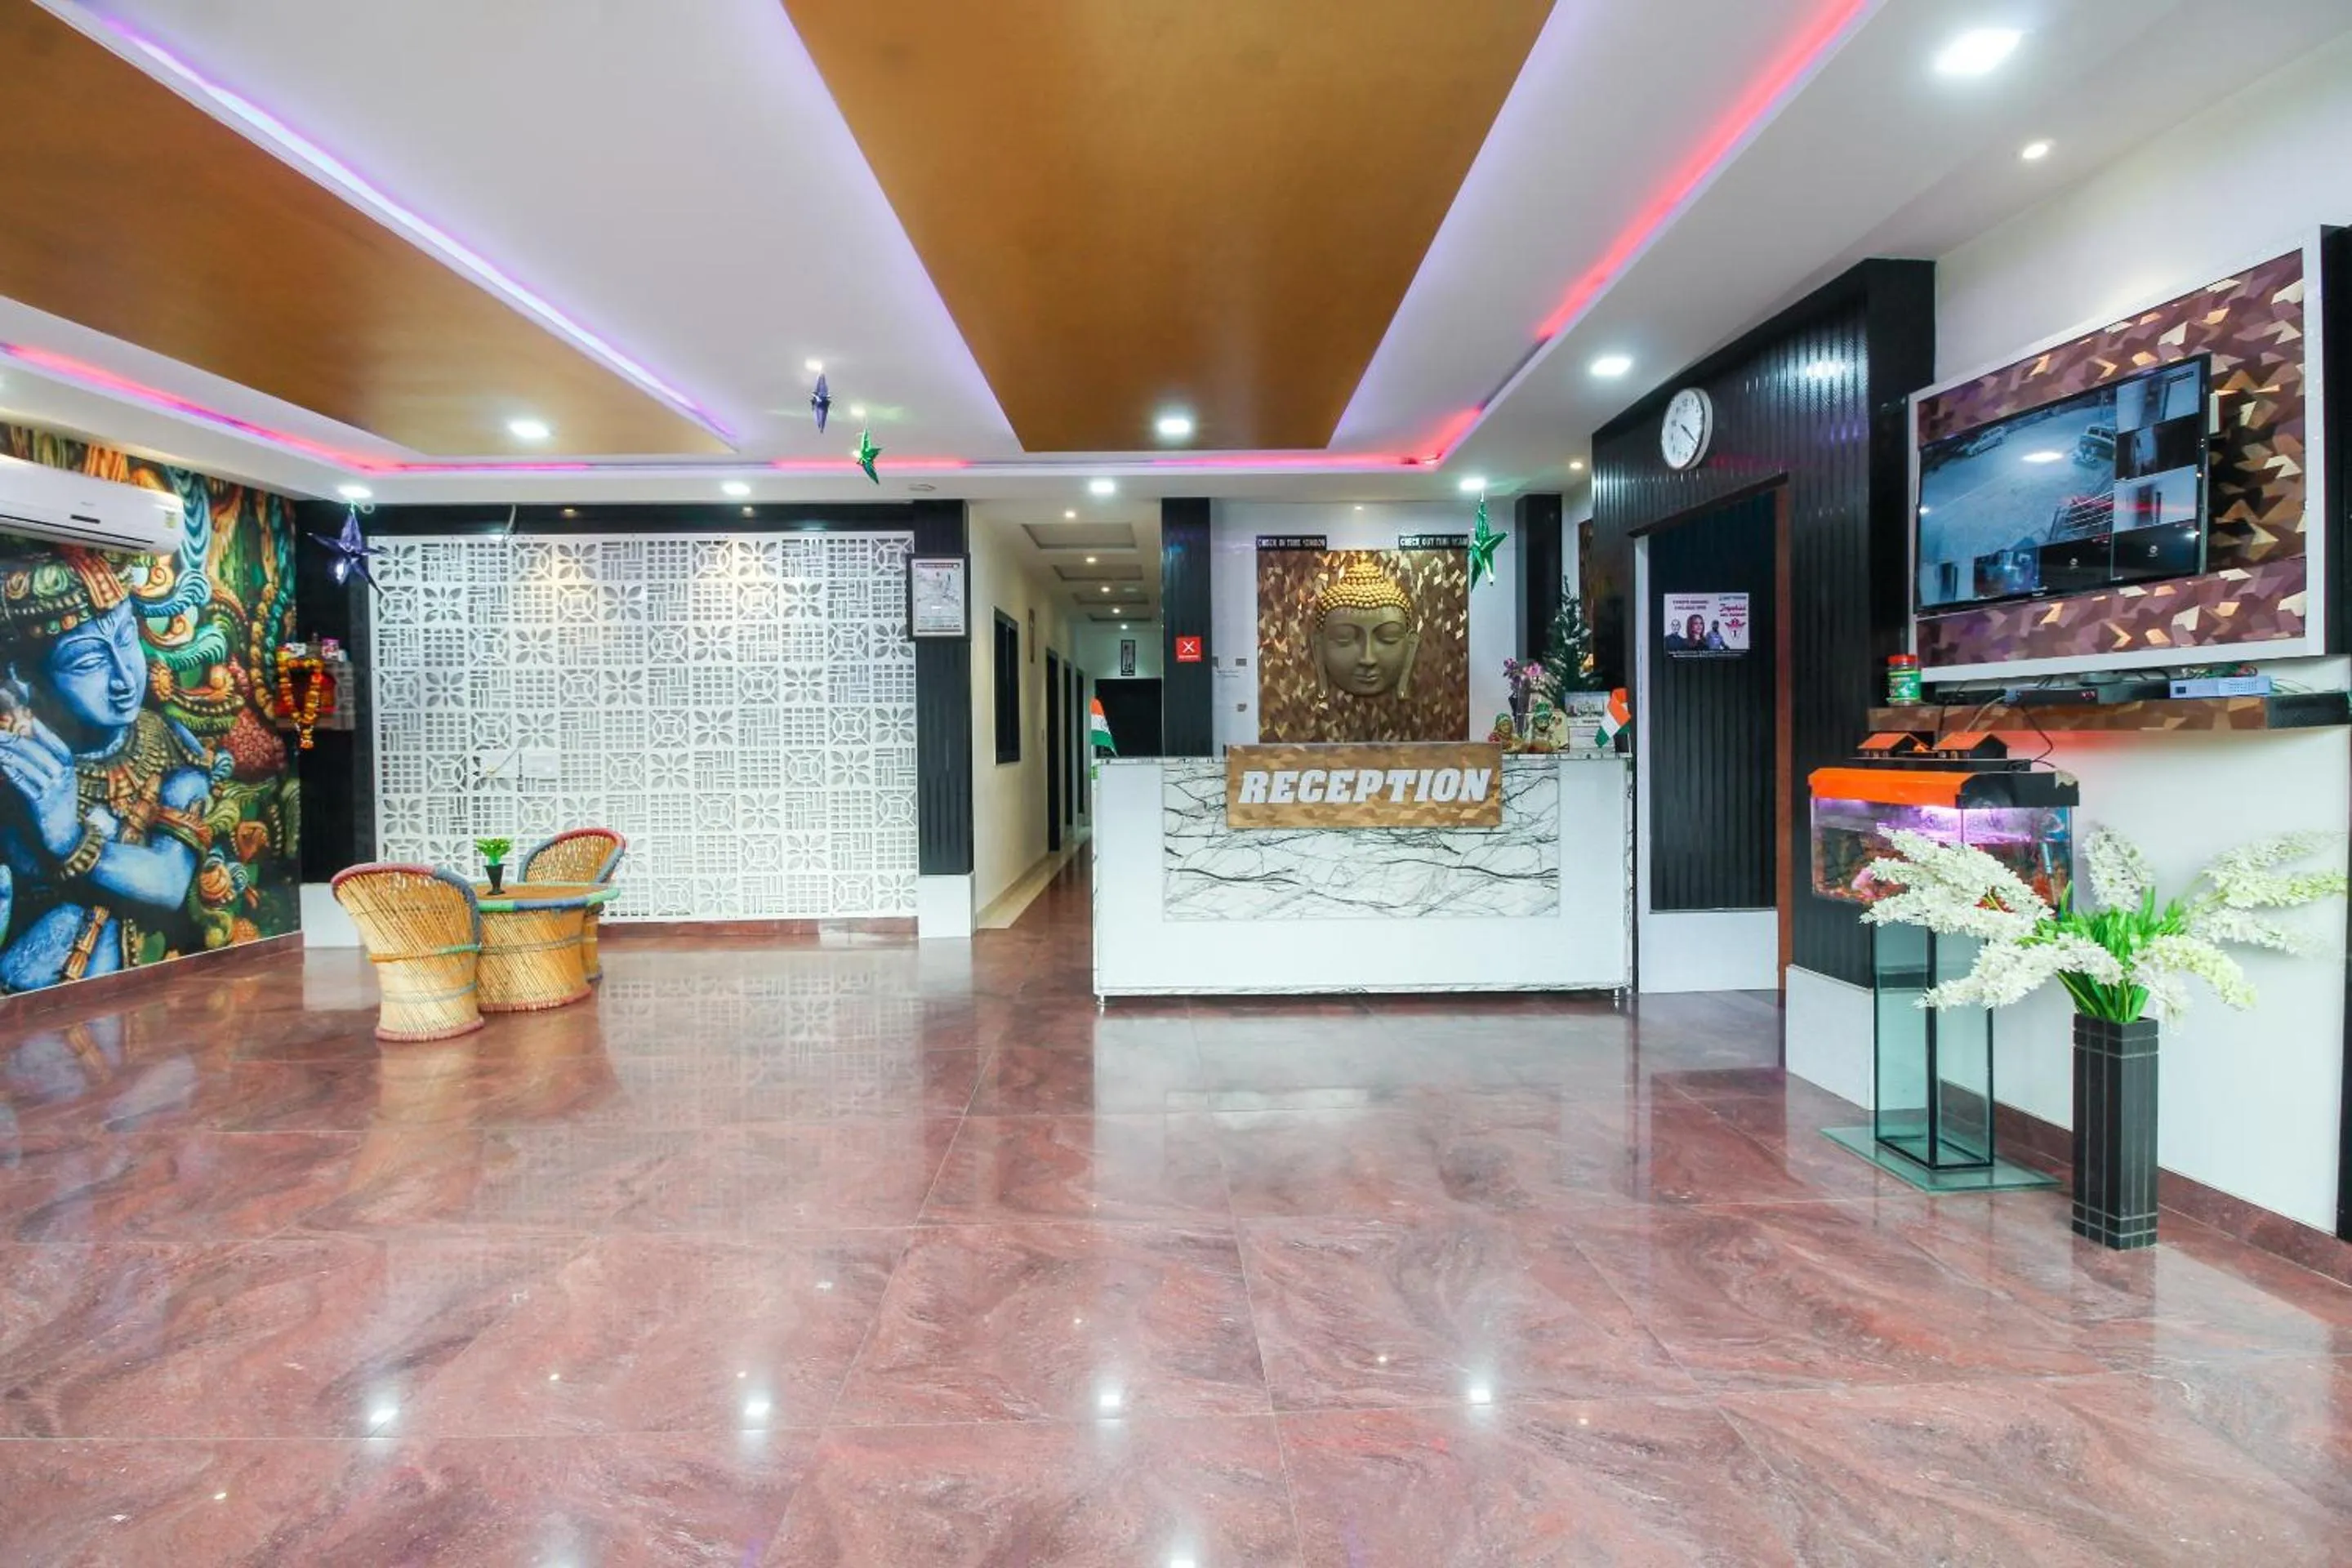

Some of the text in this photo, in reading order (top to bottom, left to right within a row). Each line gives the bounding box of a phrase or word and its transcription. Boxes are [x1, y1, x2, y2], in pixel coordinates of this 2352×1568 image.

[1400, 537, 1419, 546] CHECK
[1422, 537, 1434, 546] OUT
[1238, 768, 1491, 804] RECEPTION
